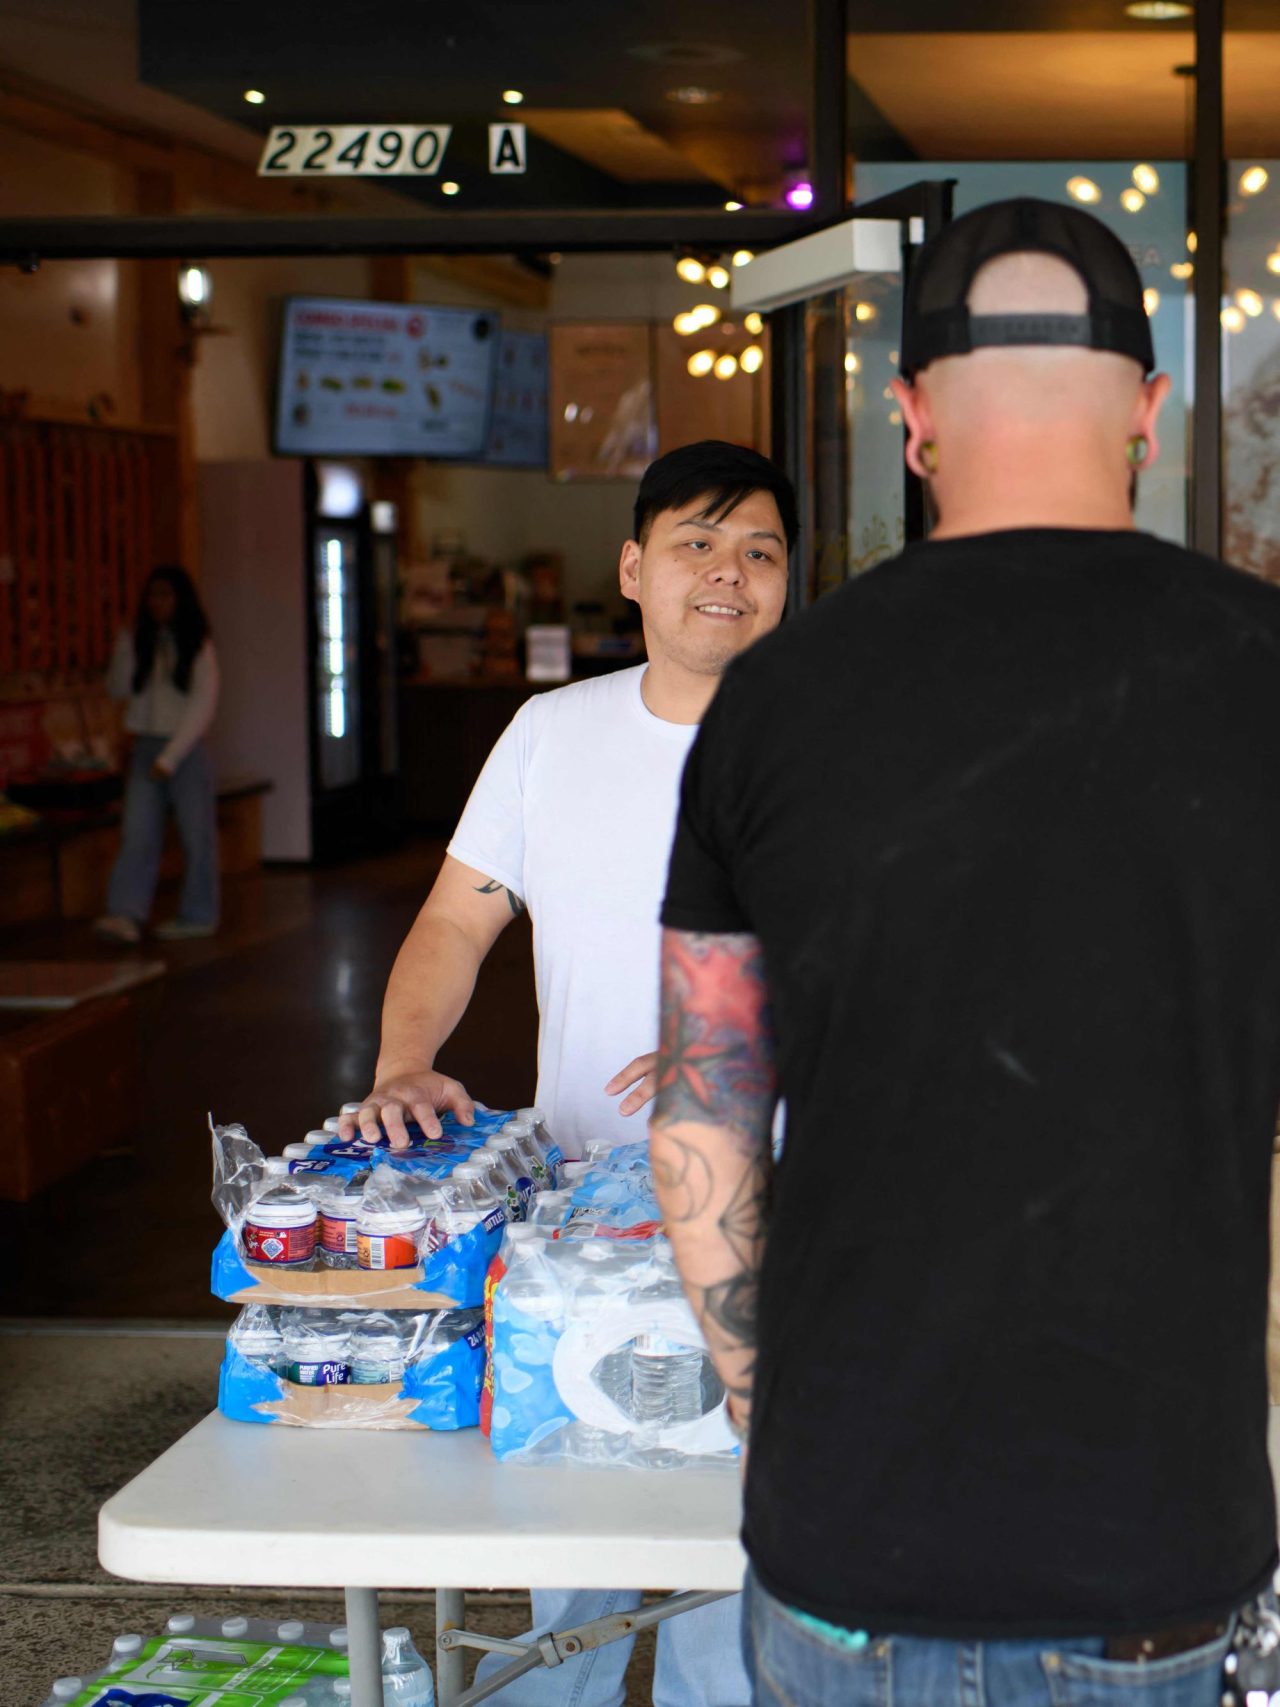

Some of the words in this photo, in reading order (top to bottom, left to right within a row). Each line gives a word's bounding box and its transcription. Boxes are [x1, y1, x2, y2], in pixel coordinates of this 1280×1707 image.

[265, 130, 440, 170] 22490
[494, 128, 521, 168] A
[322, 1361, 347, 1375] Pure
[326, 1371, 344, 1385] Life
